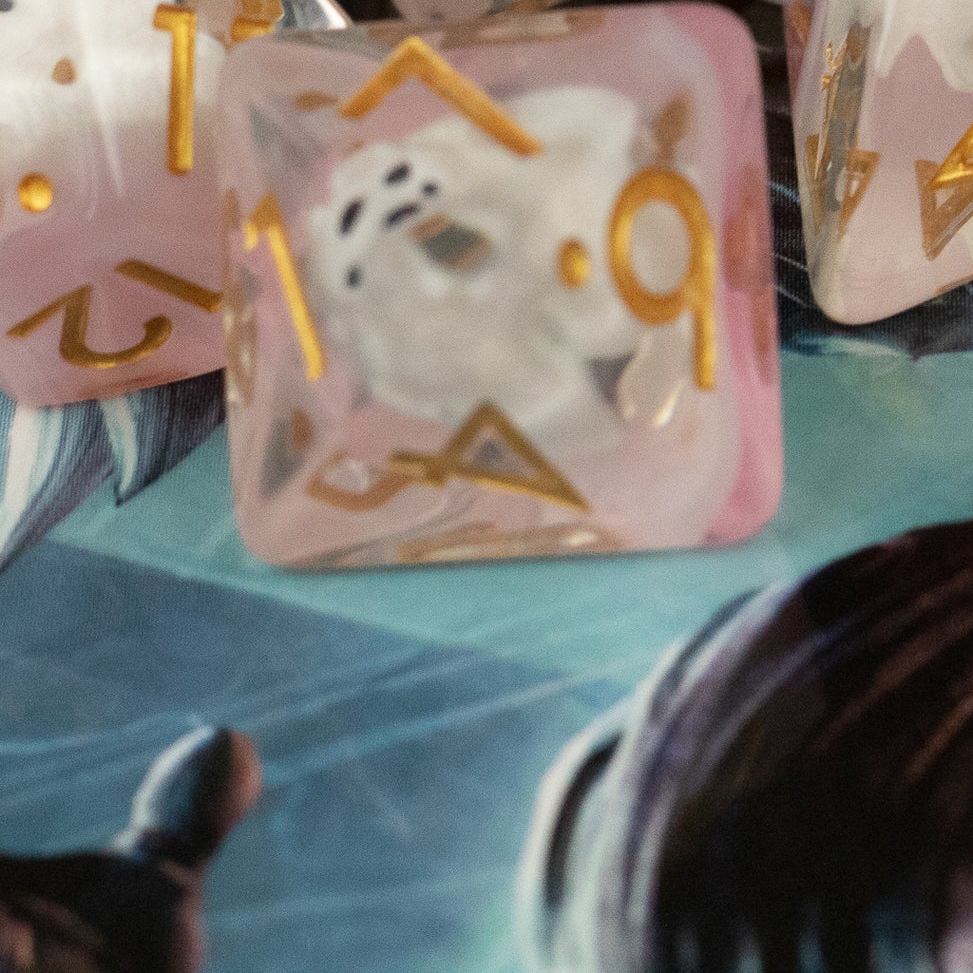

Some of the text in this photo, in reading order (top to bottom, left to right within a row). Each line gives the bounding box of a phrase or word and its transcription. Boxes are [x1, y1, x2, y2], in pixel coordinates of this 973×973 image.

[339, 36, 545, 158] 7
[244, 191, 325, 382] 1
[389, 400, 593, 514] 4
